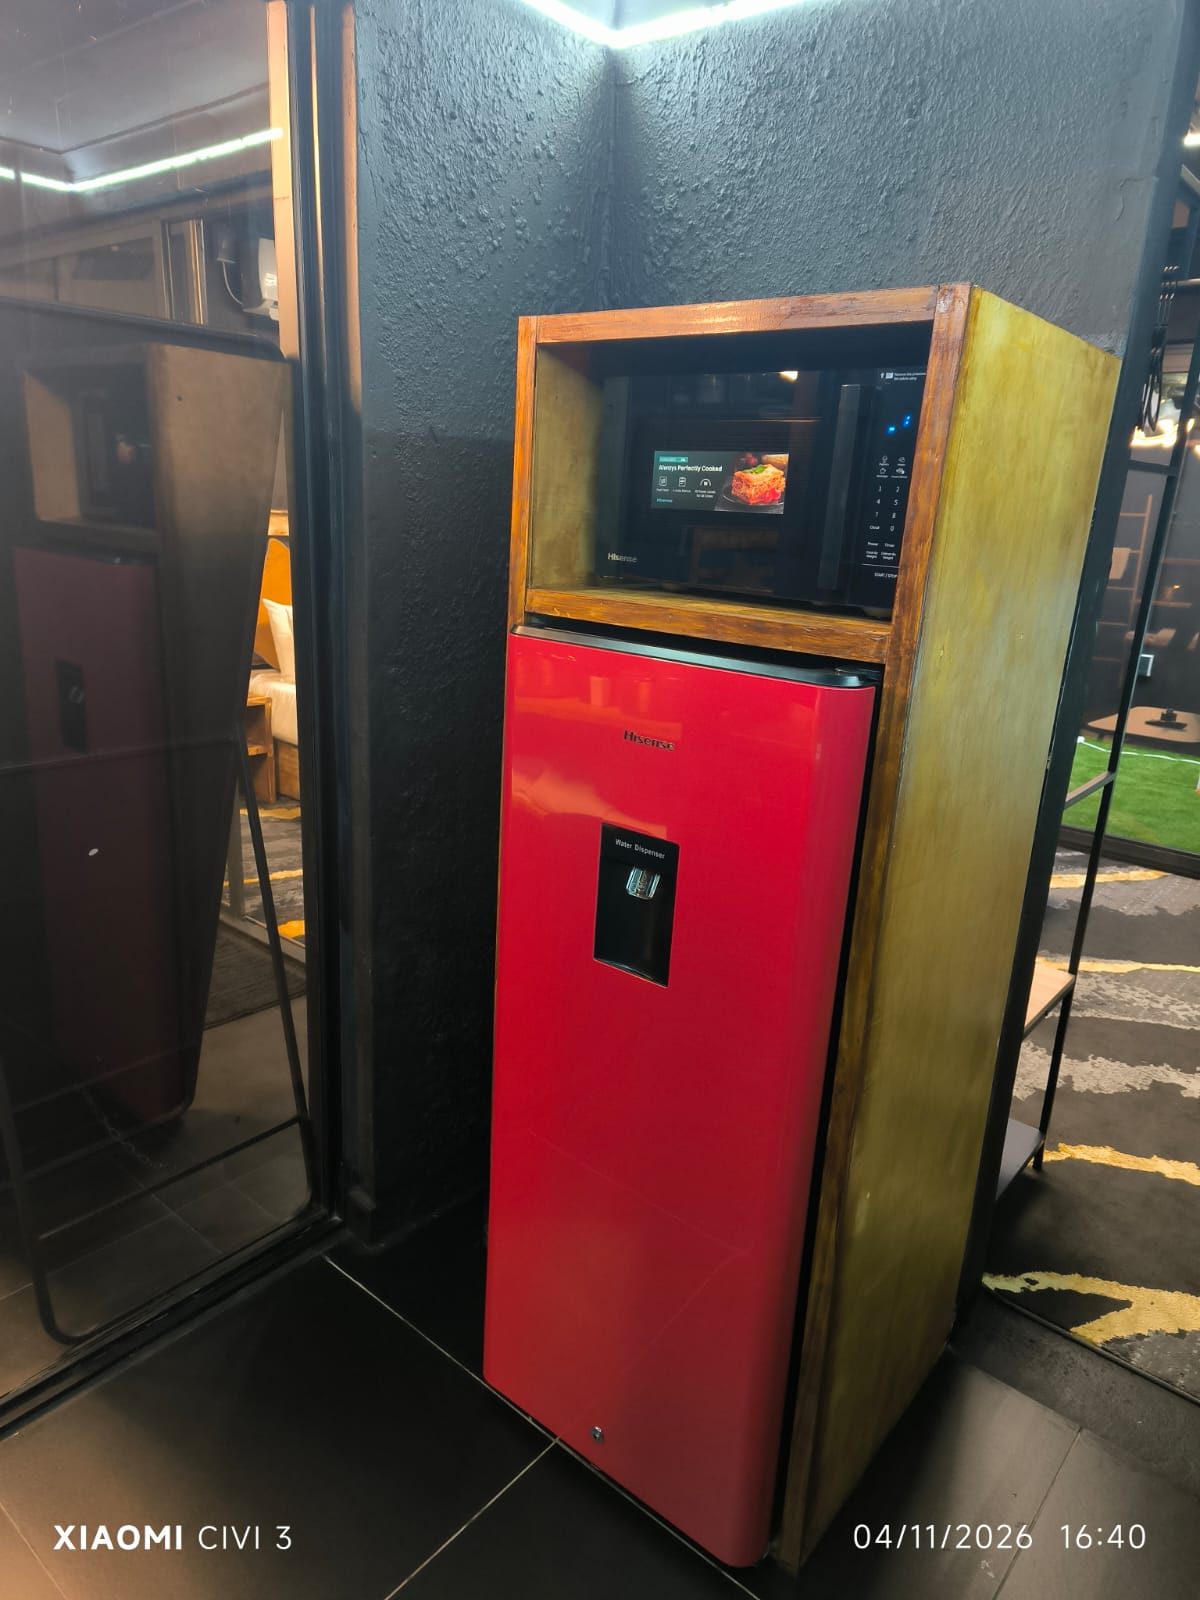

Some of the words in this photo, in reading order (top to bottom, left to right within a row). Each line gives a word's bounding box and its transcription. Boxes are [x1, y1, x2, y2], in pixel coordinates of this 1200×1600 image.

[658, 464, 677, 472] Always
[677, 464, 701, 472] Perfectly
[607, 552, 638, 563] Hisense
[624, 729, 675, 752] Hisense
[615, 839, 632, 849] Water
[634, 844, 666, 859] Dispenser
